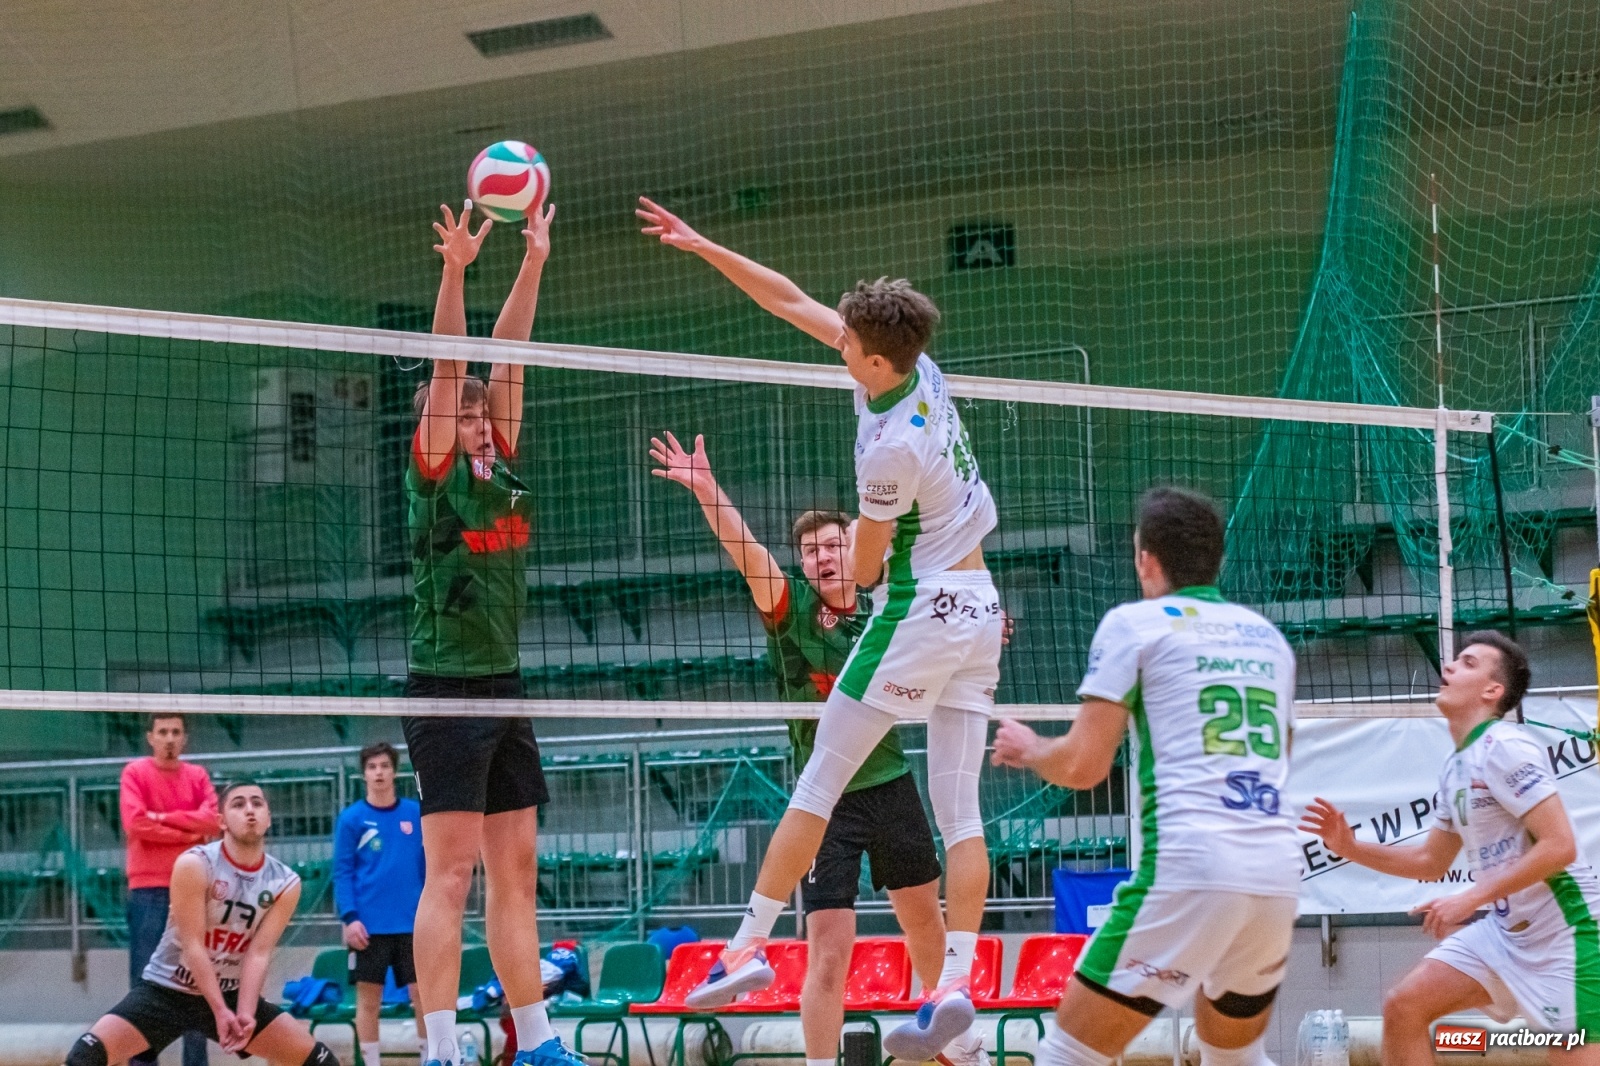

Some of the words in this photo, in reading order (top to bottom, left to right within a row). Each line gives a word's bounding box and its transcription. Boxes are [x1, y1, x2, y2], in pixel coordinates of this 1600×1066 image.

[869, 498, 899, 507] UNIMOT
[882, 681, 926, 701] BTSPORT
[1197, 684, 1281, 760] 25
[1370, 807, 1402, 844] W
